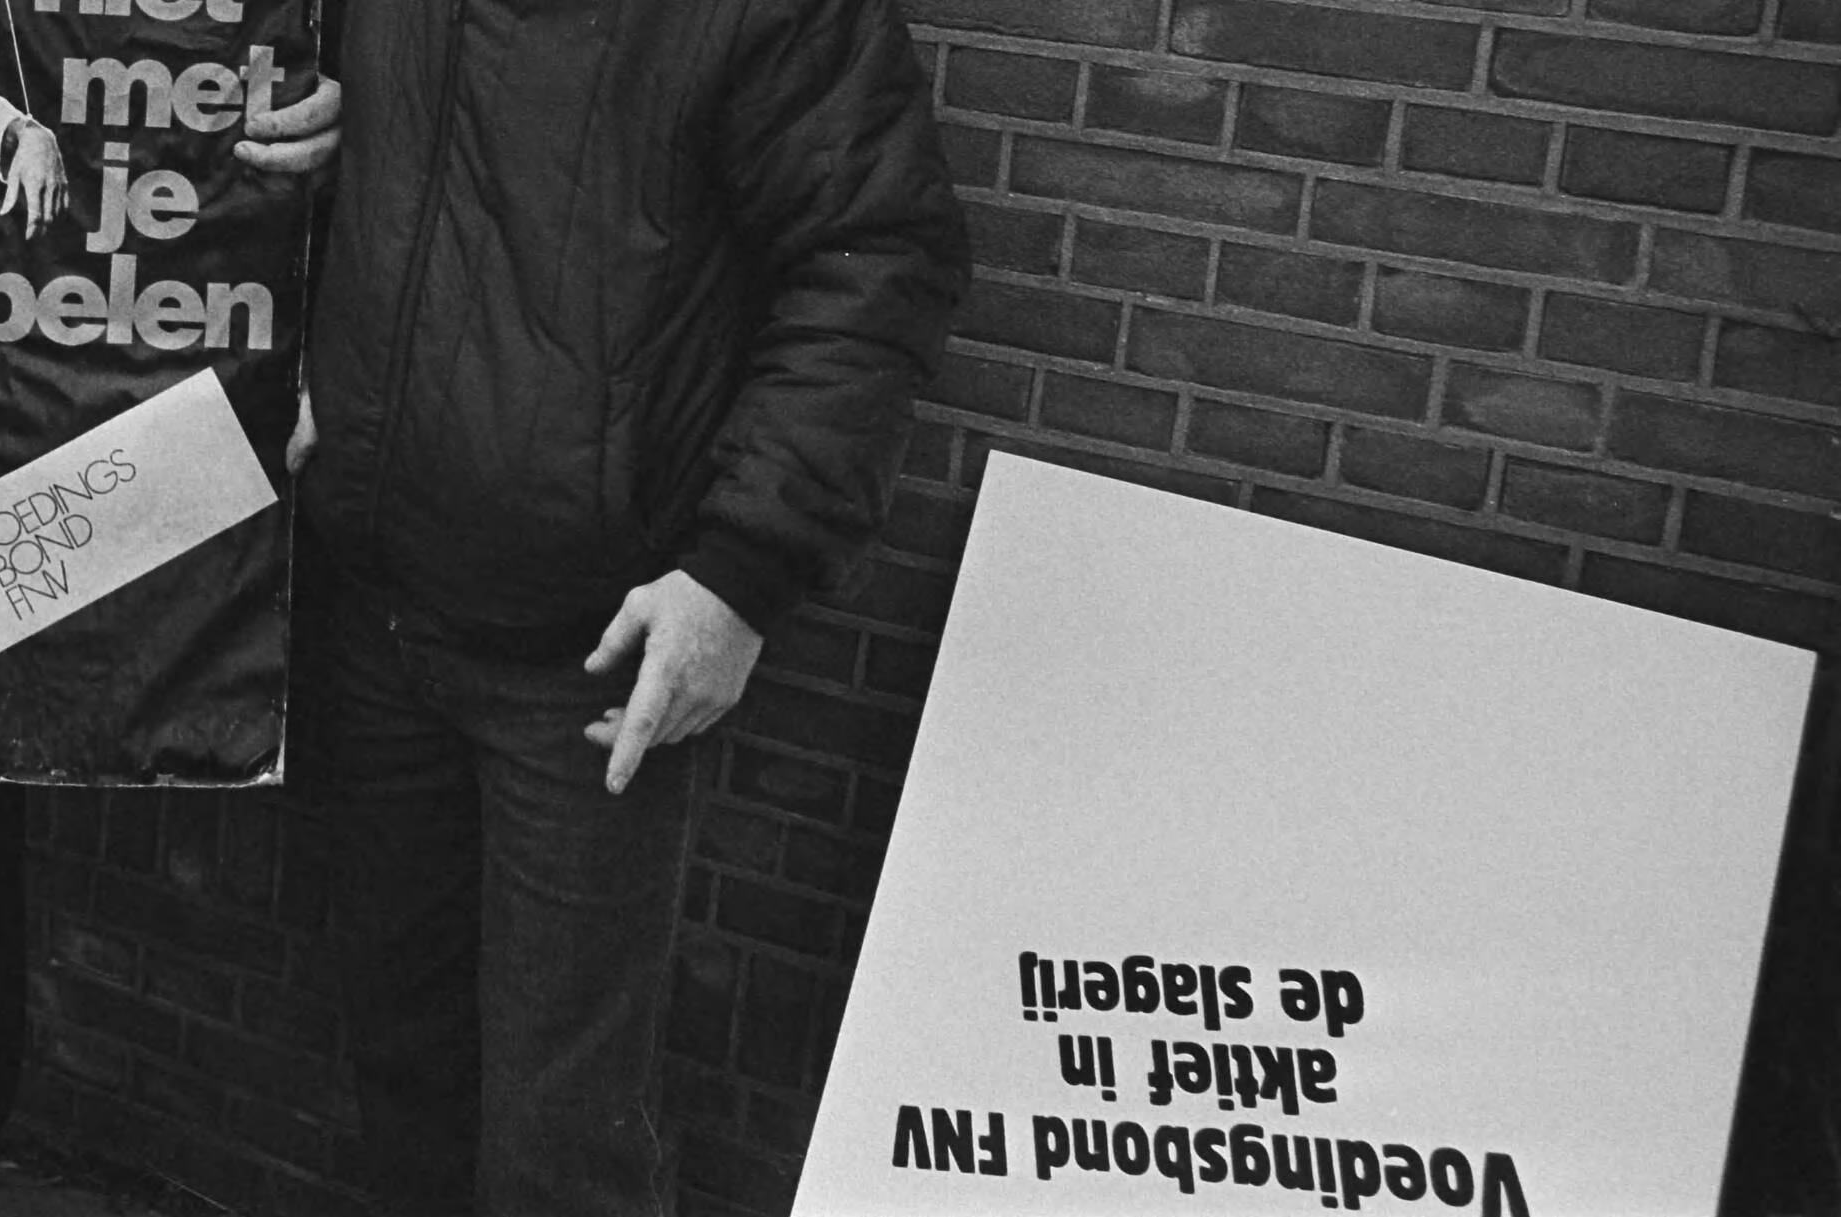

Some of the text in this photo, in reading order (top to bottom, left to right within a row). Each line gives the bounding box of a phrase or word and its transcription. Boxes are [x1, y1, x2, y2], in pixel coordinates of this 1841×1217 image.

[61, 45, 284, 133] met
[86, 142, 199, 253] je
[5, 560, 70, 621] FNV
[1018, 951, 1364, 1037] de slagerij
[1059, 1034, 1337, 1116] aktief in
[892, 1105, 1530, 1217] Voedingsbond FNV
